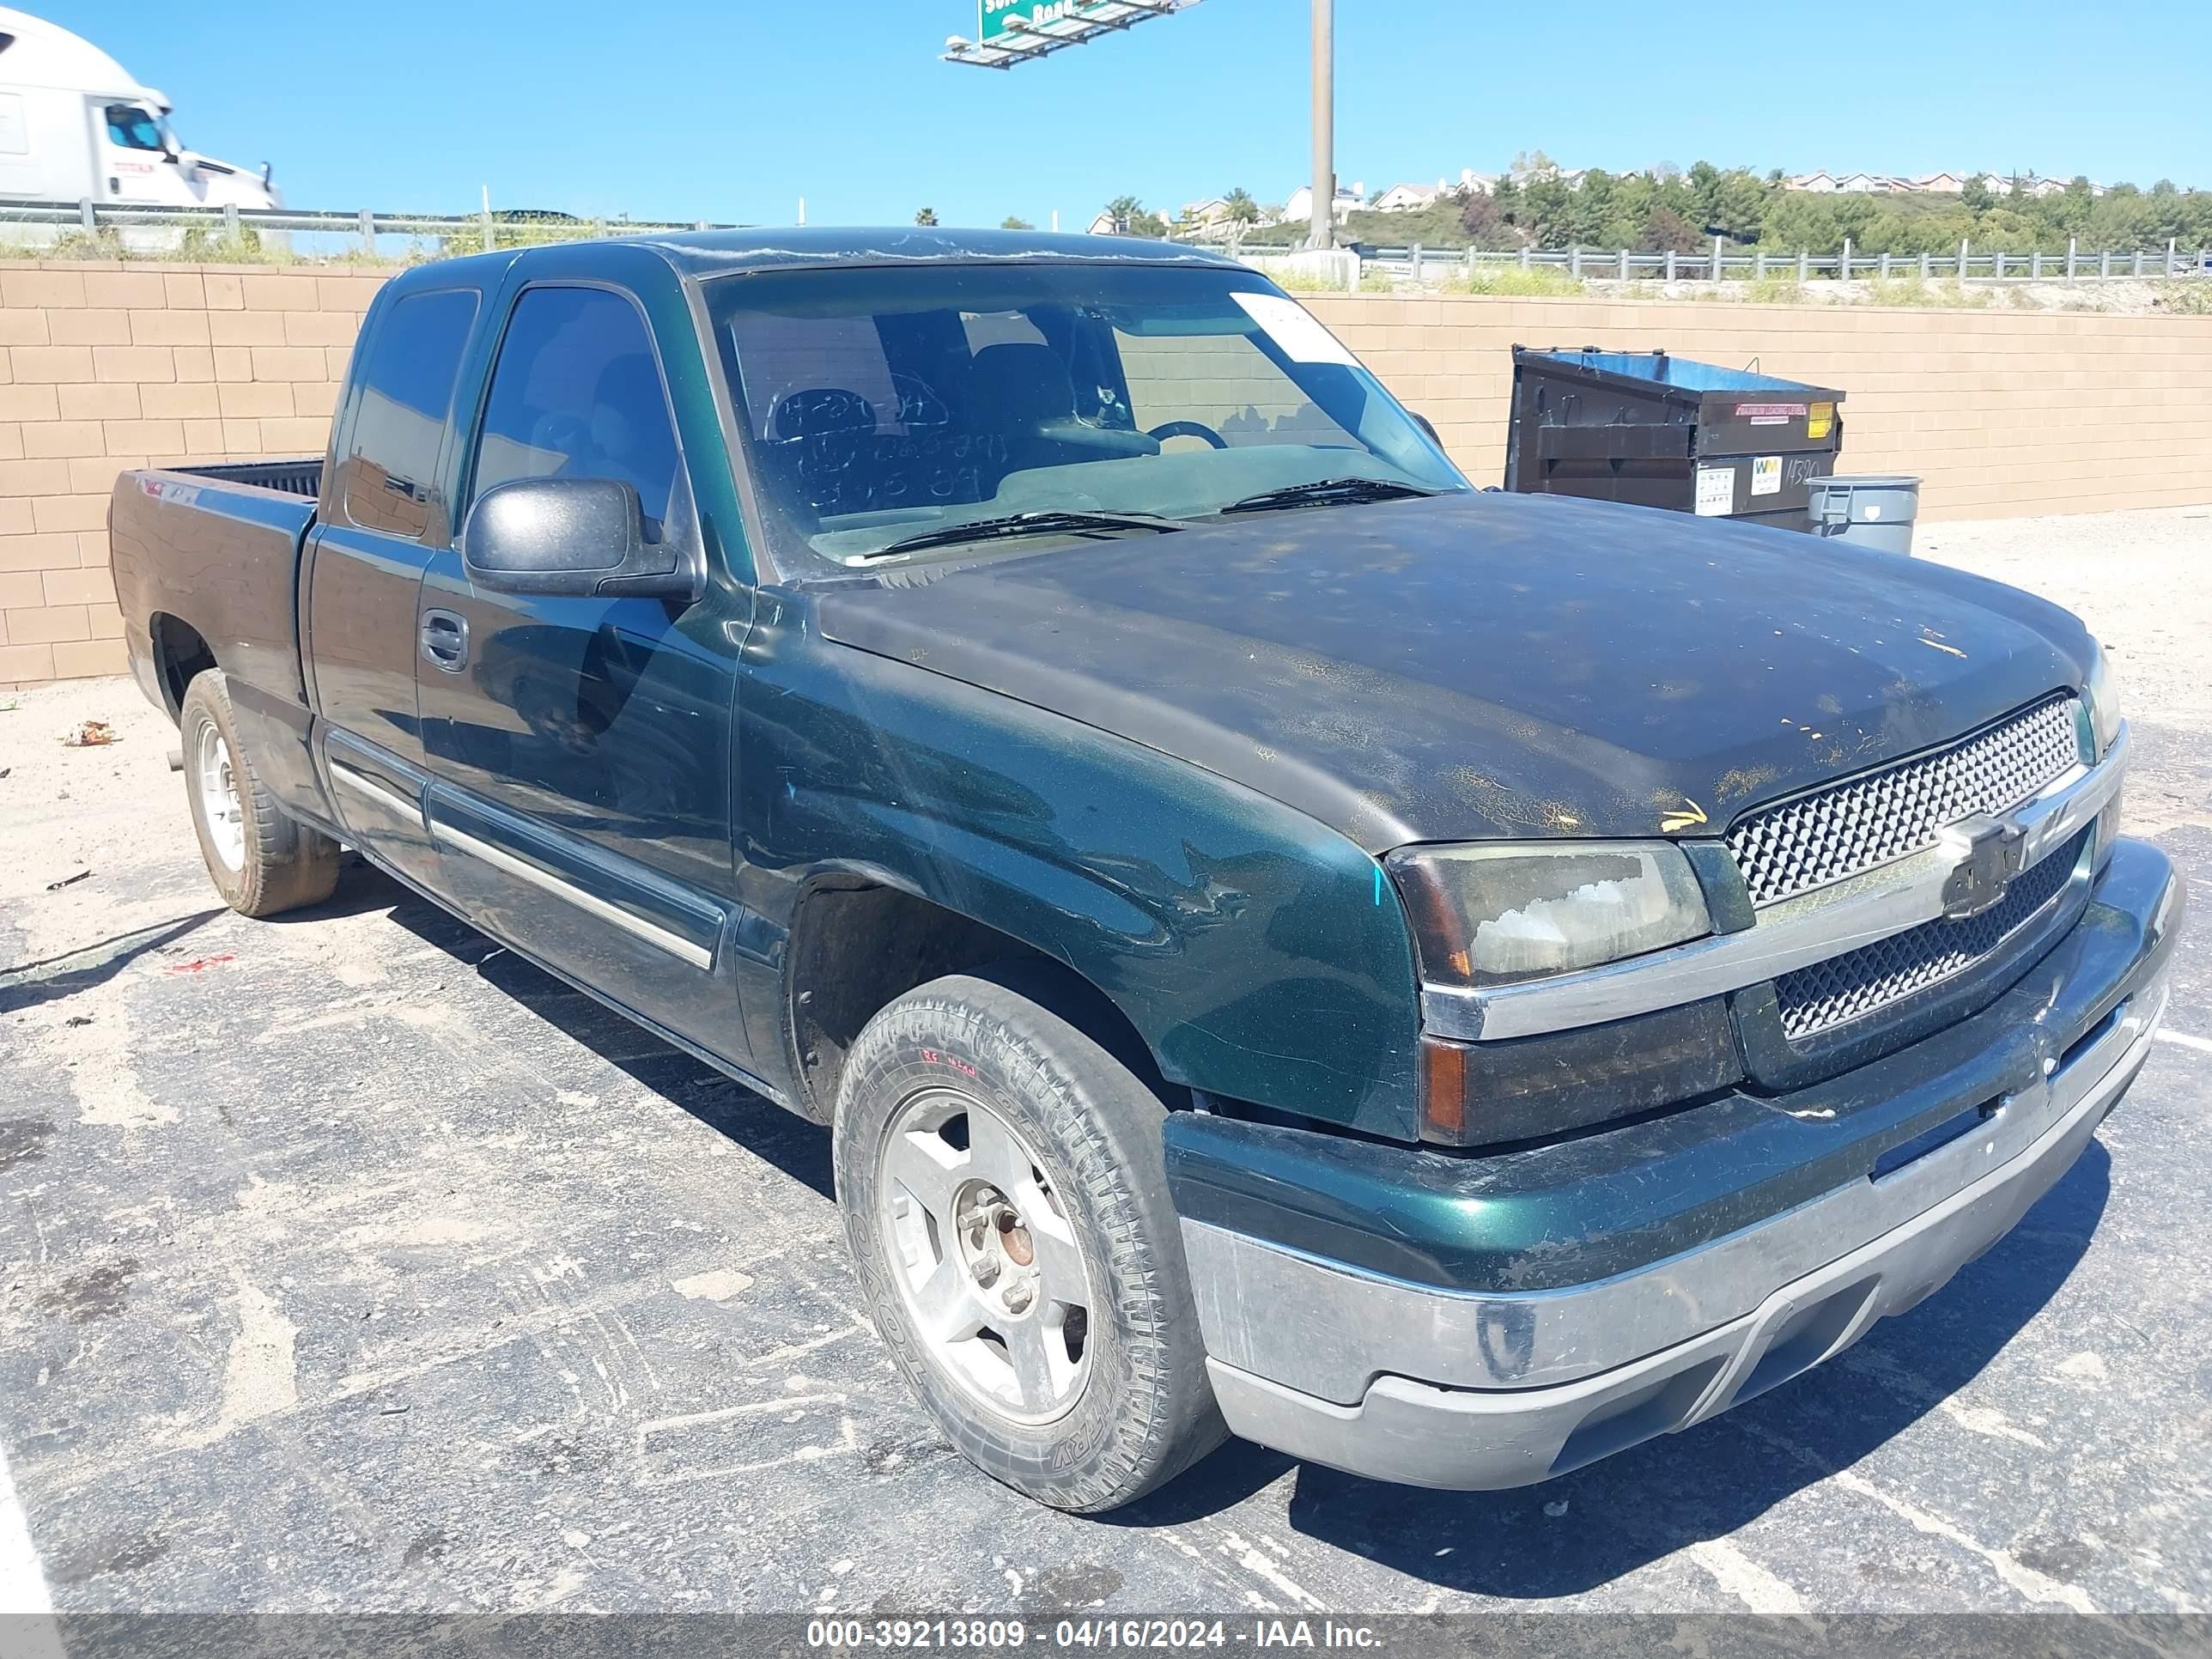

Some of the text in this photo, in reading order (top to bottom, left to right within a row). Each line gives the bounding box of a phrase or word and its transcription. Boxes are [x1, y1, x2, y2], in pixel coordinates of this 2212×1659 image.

[1033, 0, 1073, 23] Road
[1756, 459, 1778, 474] WM
[848, 1210, 927, 1387] TOYO
